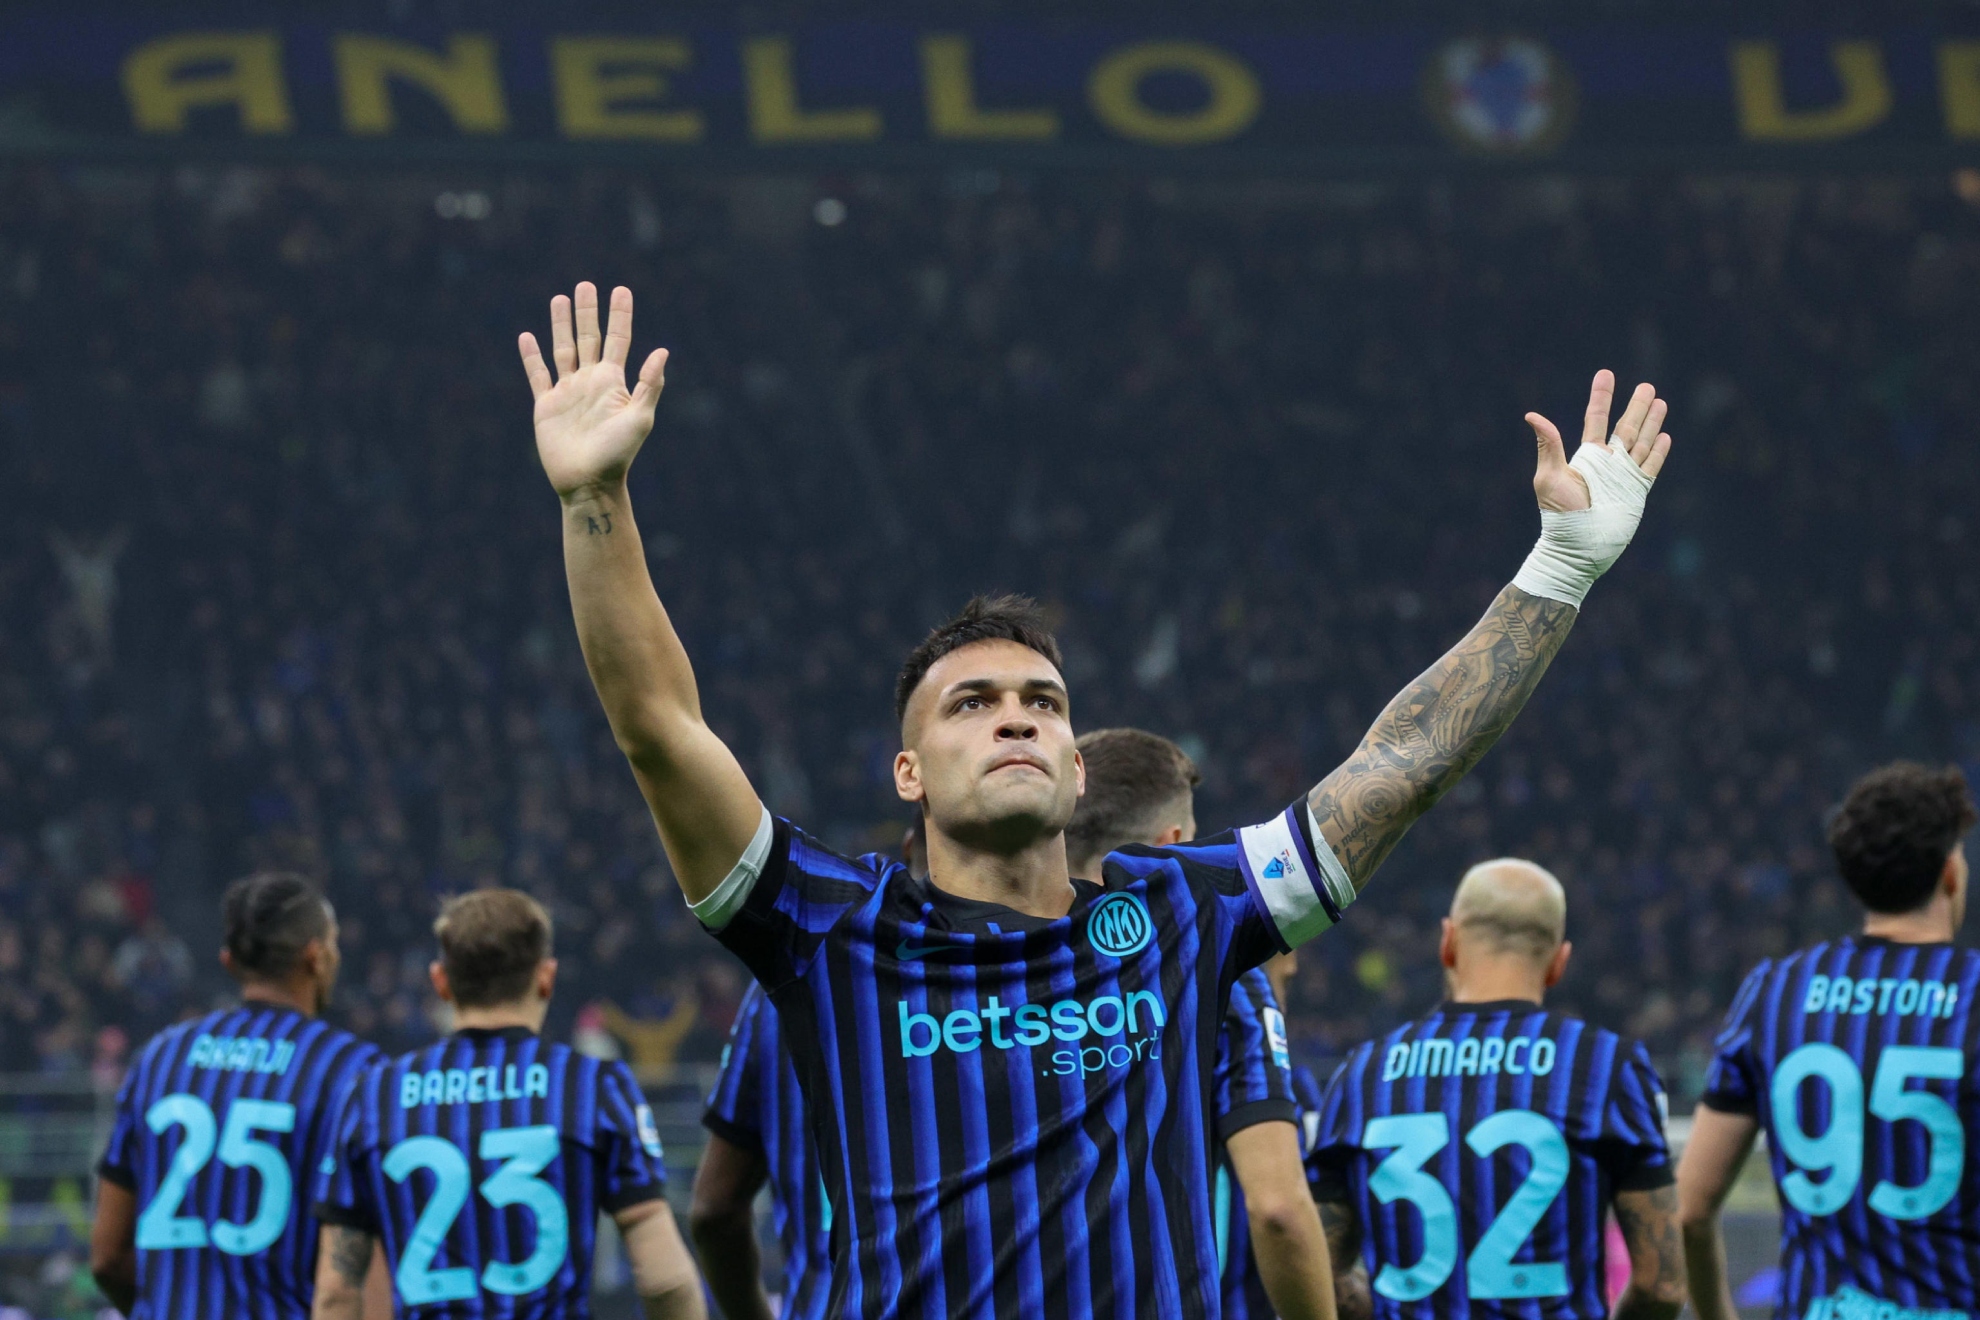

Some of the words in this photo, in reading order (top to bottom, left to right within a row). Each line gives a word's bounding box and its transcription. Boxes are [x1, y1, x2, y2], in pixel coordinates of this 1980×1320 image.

[122, 33, 1263, 143] ANELLO
[898, 990, 1165, 1058] betsson
[1804, 974, 1958, 1019] BASTONI
[400, 1062, 549, 1109] BARELLA
[1382, 1036, 1557, 1082] DIMARCO
[135, 1093, 295, 1256] 25
[1770, 1042, 1965, 1220] 95
[382, 1125, 569, 1304] 23
[1362, 1109, 1570, 1302] 32
